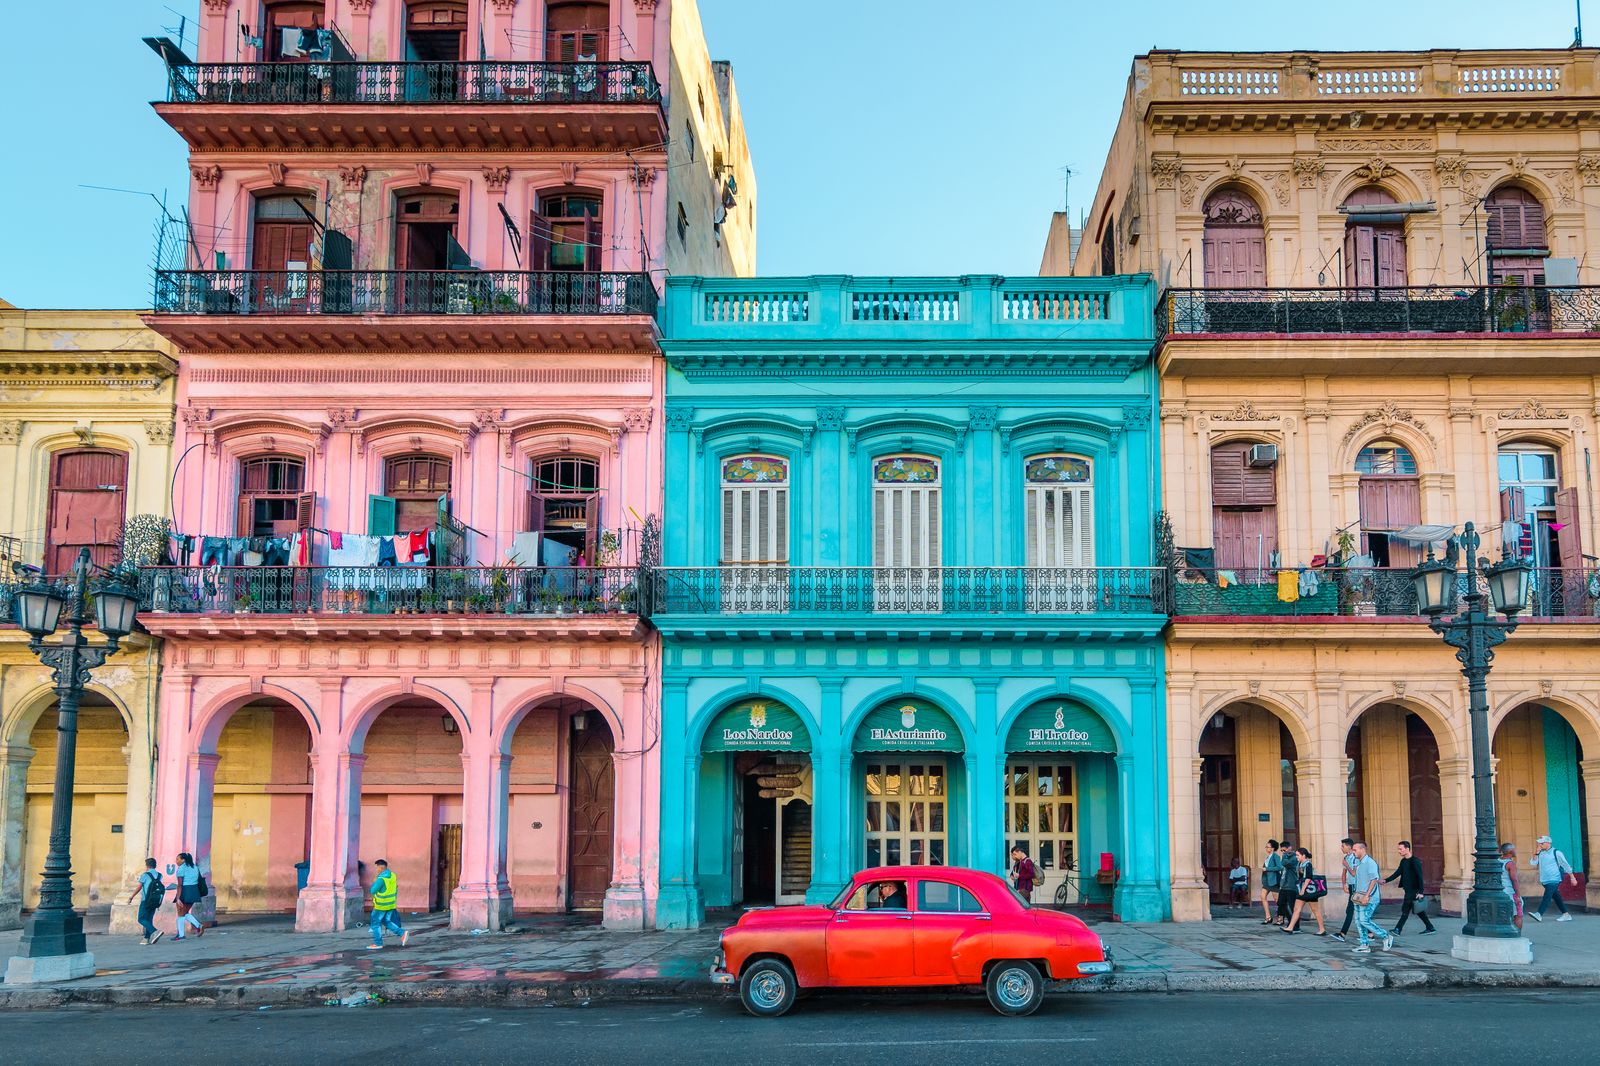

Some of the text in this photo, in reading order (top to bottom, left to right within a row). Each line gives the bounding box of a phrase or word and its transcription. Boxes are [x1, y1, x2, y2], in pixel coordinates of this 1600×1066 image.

[724, 729, 793, 740] Los Nardos
[871, 728, 947, 740] El Asturianito
[1029, 729, 1089, 740] El Trofeo
